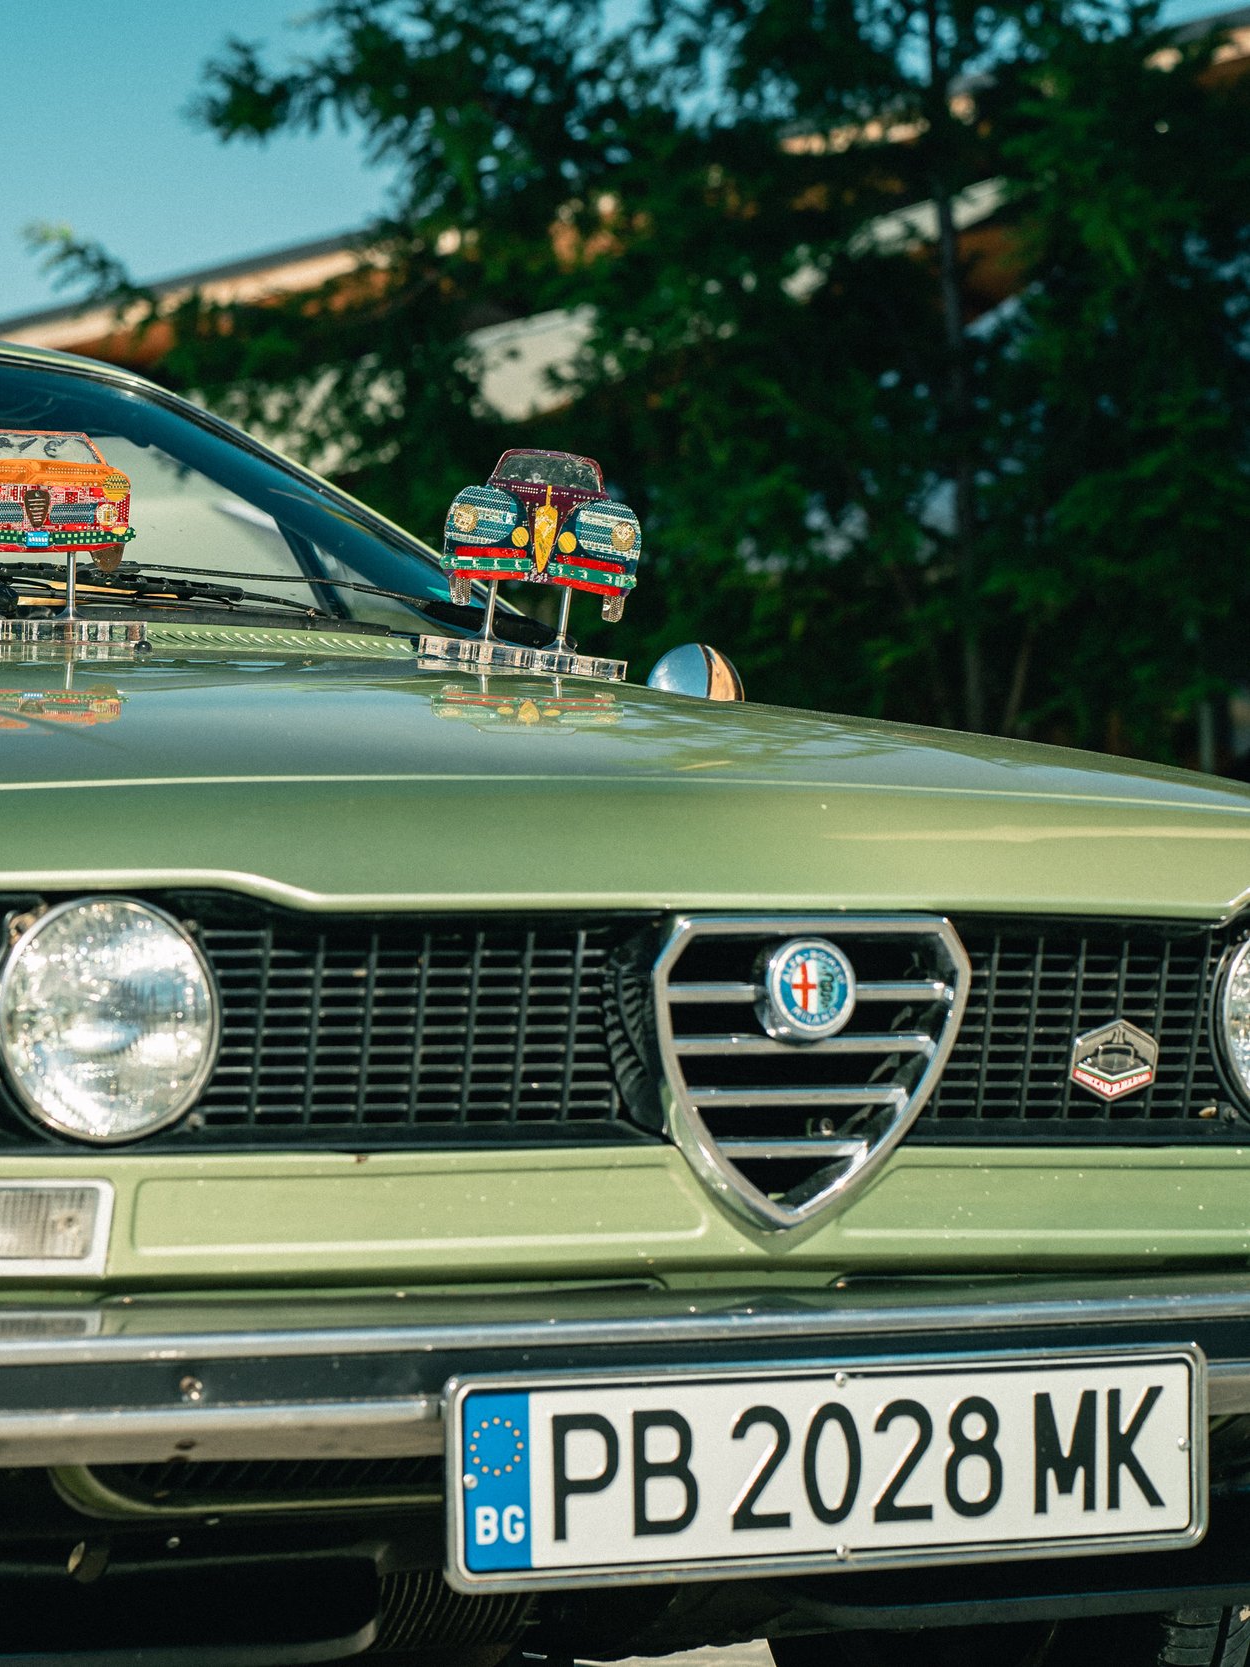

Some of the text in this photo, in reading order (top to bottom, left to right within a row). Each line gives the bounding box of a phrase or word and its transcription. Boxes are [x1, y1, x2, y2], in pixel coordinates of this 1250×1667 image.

[550, 1385, 1167, 1543] PB 2028 MK
[474, 1505, 526, 1546] BG
